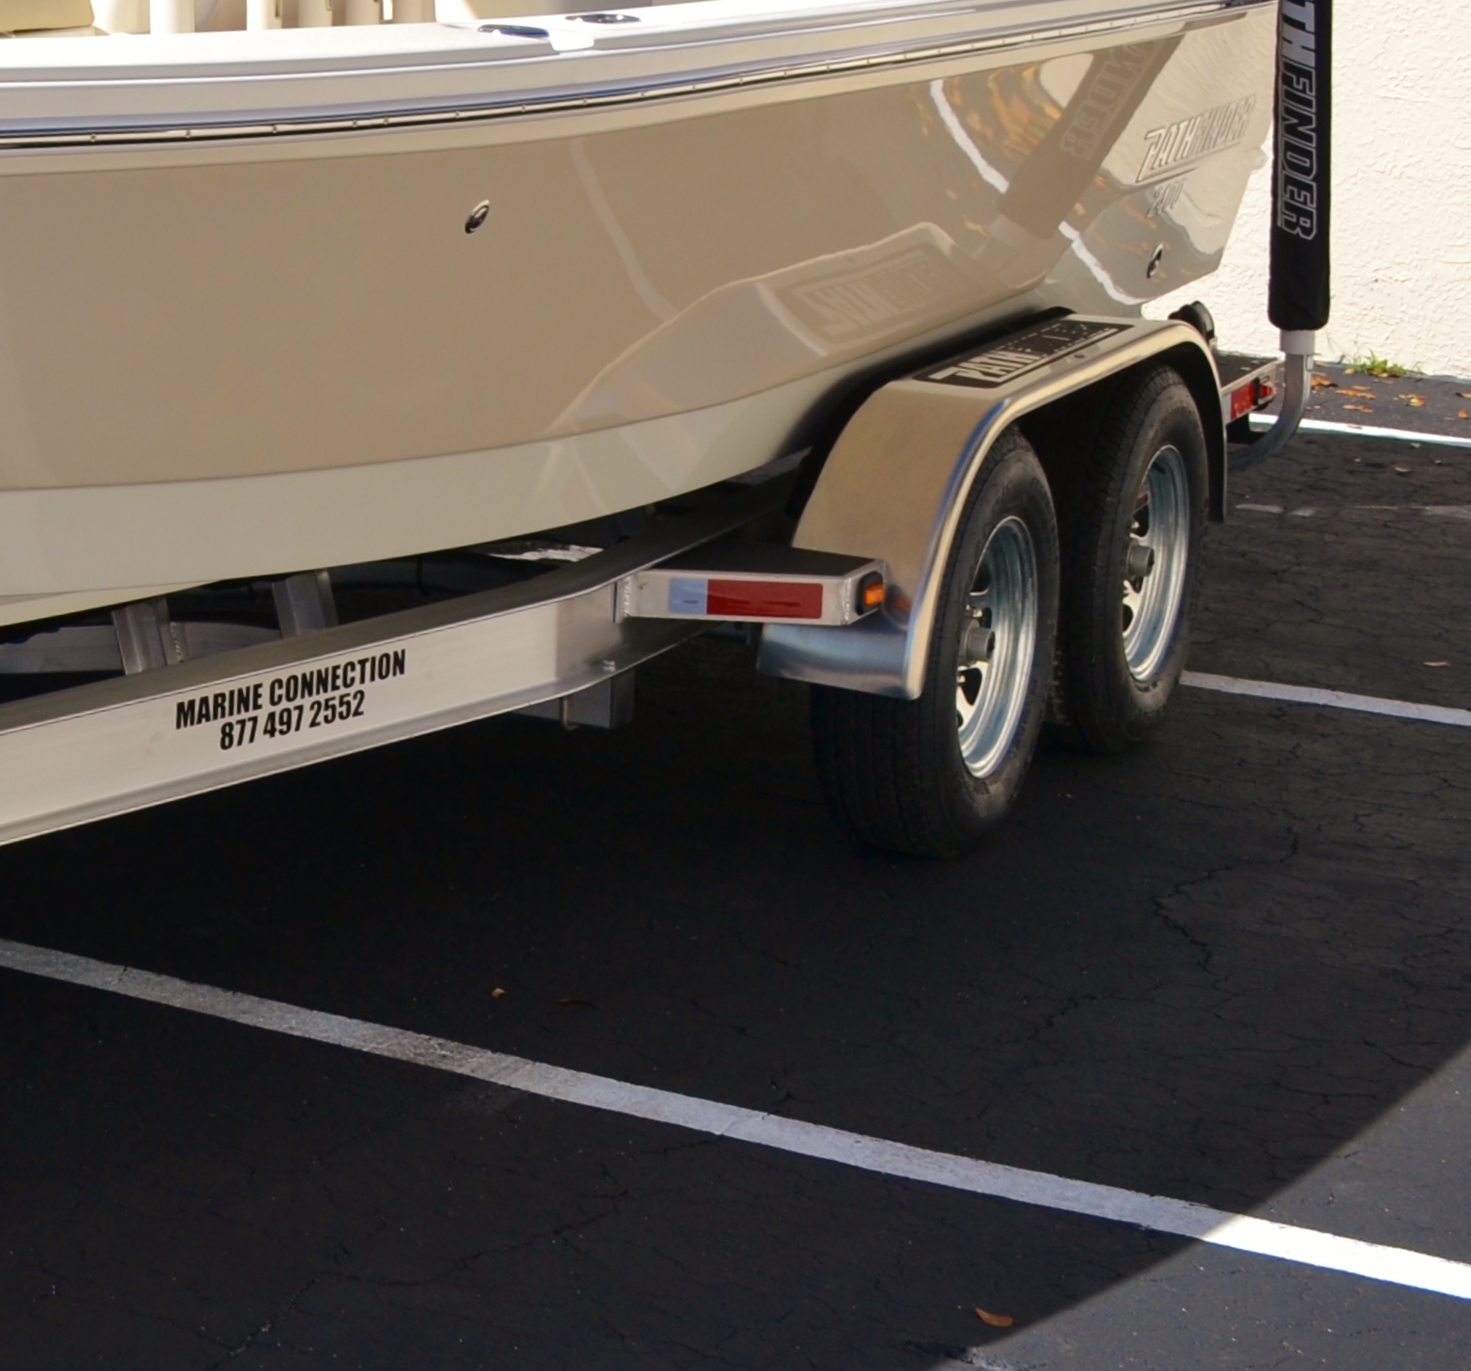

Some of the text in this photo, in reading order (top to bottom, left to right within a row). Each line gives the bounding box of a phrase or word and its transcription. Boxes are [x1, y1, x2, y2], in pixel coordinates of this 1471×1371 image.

[1135, 93, 1257, 184] PATHFINDER
[175, 648, 407, 730] MARINE CONNECTION
[219, 689, 366, 750] 877 497 2552
